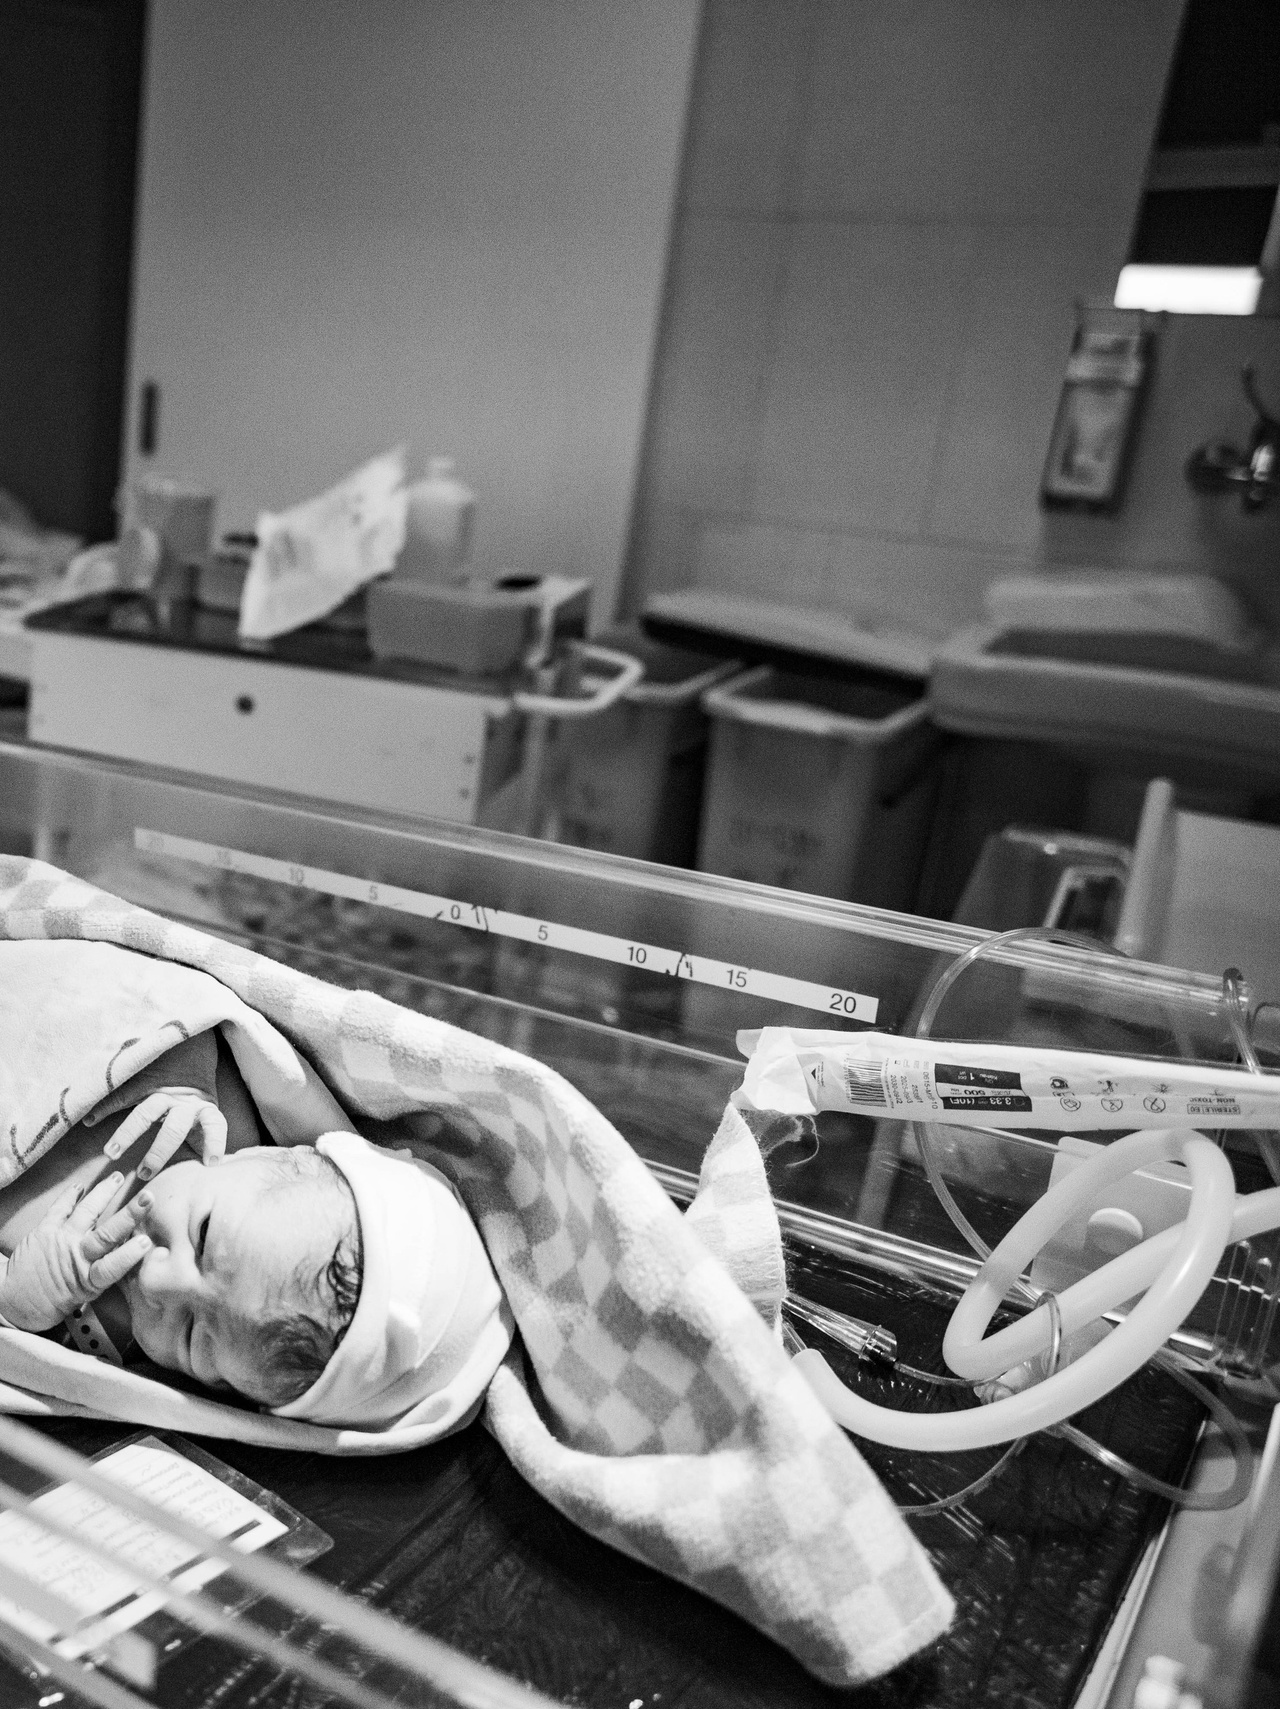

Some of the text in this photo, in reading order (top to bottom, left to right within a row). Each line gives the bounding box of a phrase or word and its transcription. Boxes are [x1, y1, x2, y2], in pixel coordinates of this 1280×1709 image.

[450, 904, 461, 920] 0
[537, 924, 549, 942] 5
[626, 945, 648, 964] 10
[726, 968, 748, 988] 15
[828, 993, 857, 1014] 20
[989, 1097, 1012, 1106] 3.33
